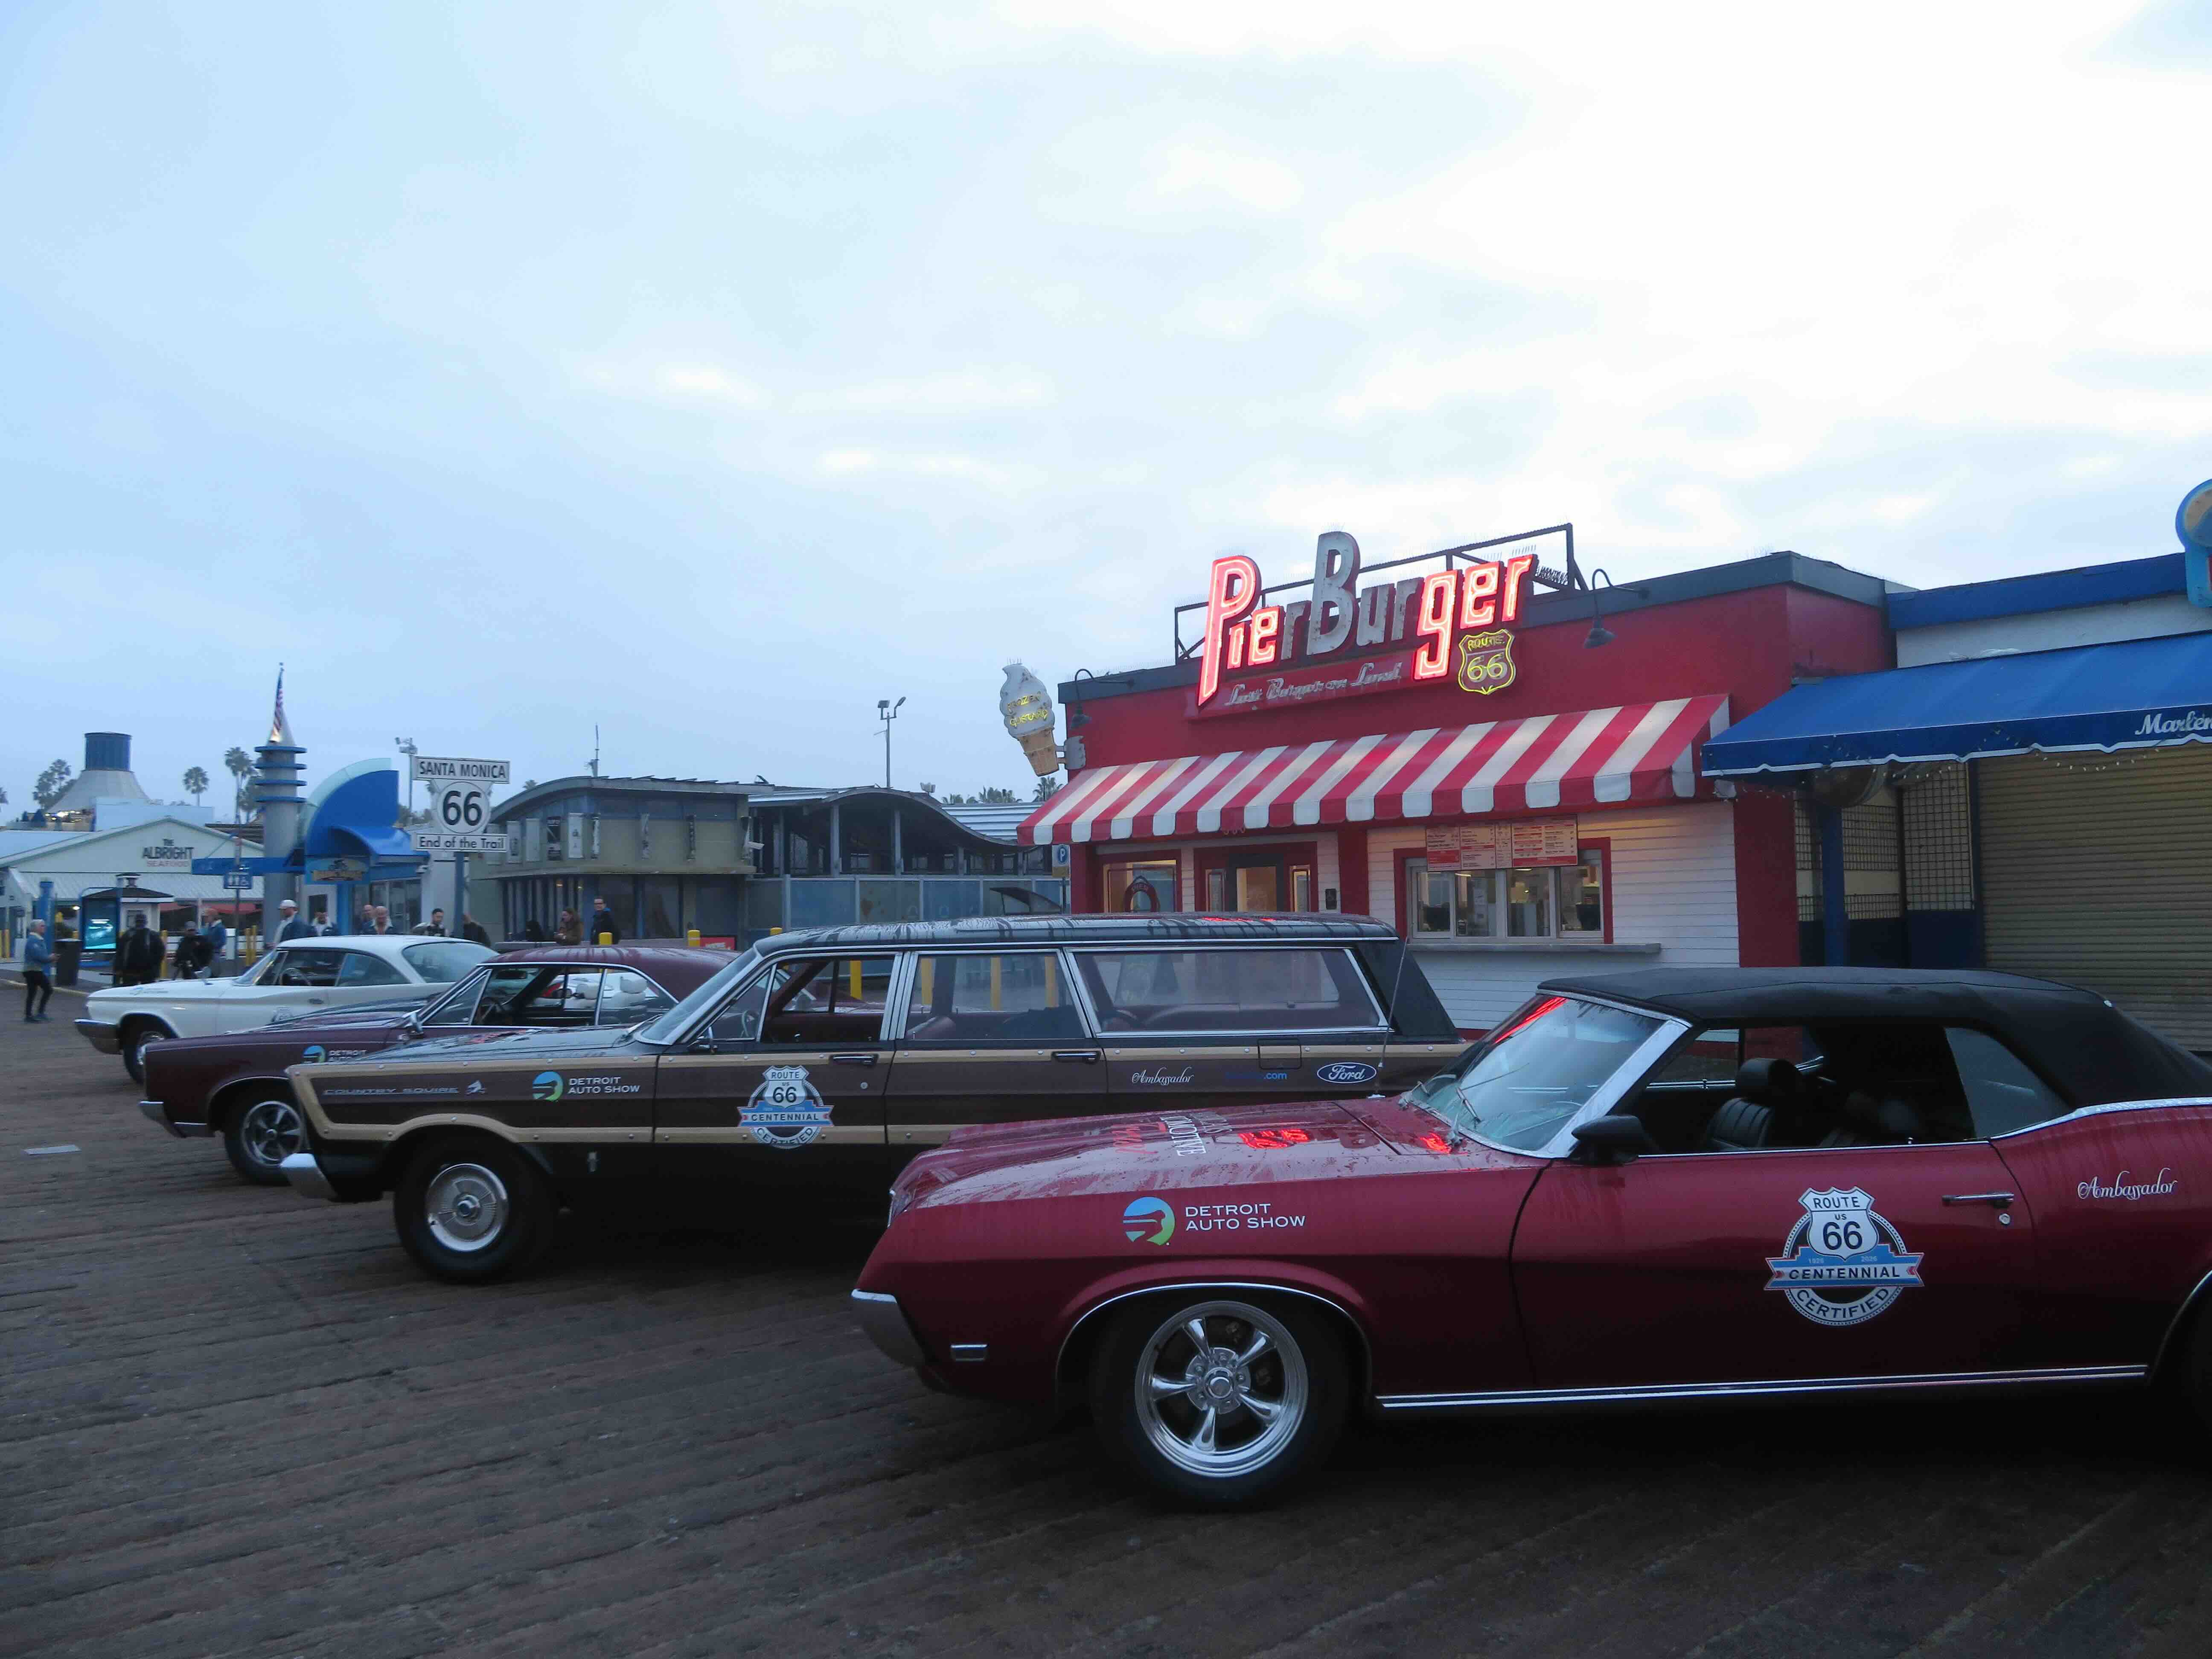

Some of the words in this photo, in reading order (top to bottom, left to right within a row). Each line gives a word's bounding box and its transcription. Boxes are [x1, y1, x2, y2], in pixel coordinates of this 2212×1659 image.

[1199, 531, 1537, 707] PierBurger
[1467, 635, 1505, 651] ROUTE
[1467, 652, 1508, 682] 66
[1007, 690, 1041, 714] FROZEN
[419, 761, 456, 776] SANTA
[460, 764, 506, 778] MONICA
[443, 790, 483, 826] 66
[419, 836, 441, 847] End
[444, 836, 456, 848] of
[460, 836, 477, 848] the
[481, 837, 504, 849] Trail
[142, 847, 195, 859] ALBRIGHT
[1060, 848, 1066, 862] P
[1132, 1066, 1194, 1086] Ambassador
[1328, 1065, 1365, 1080] Ford
[568, 1077, 621, 1086] DETROIT
[604, 1085, 640, 1093] SHOW
[773, 1086, 797, 1103] 66
[751, 1113, 819, 1121] CENTENNIAL
[757, 1128, 813, 1145] CERTIFIED
[2078, 1167, 2178, 1200] Ambassador
[1185, 1203, 1271, 1217] DETROIT
[1813, 1196, 1860, 1208] ROUTE
[1186, 1218, 1240, 1231] AUTO
[1247, 1216, 1305, 1228] SHOW
[1822, 1221, 1863, 1250] 66
[1789, 1266, 1900, 1280] CENTENNIAL
[1797, 1288, 1890, 1318] CERTIFIED
